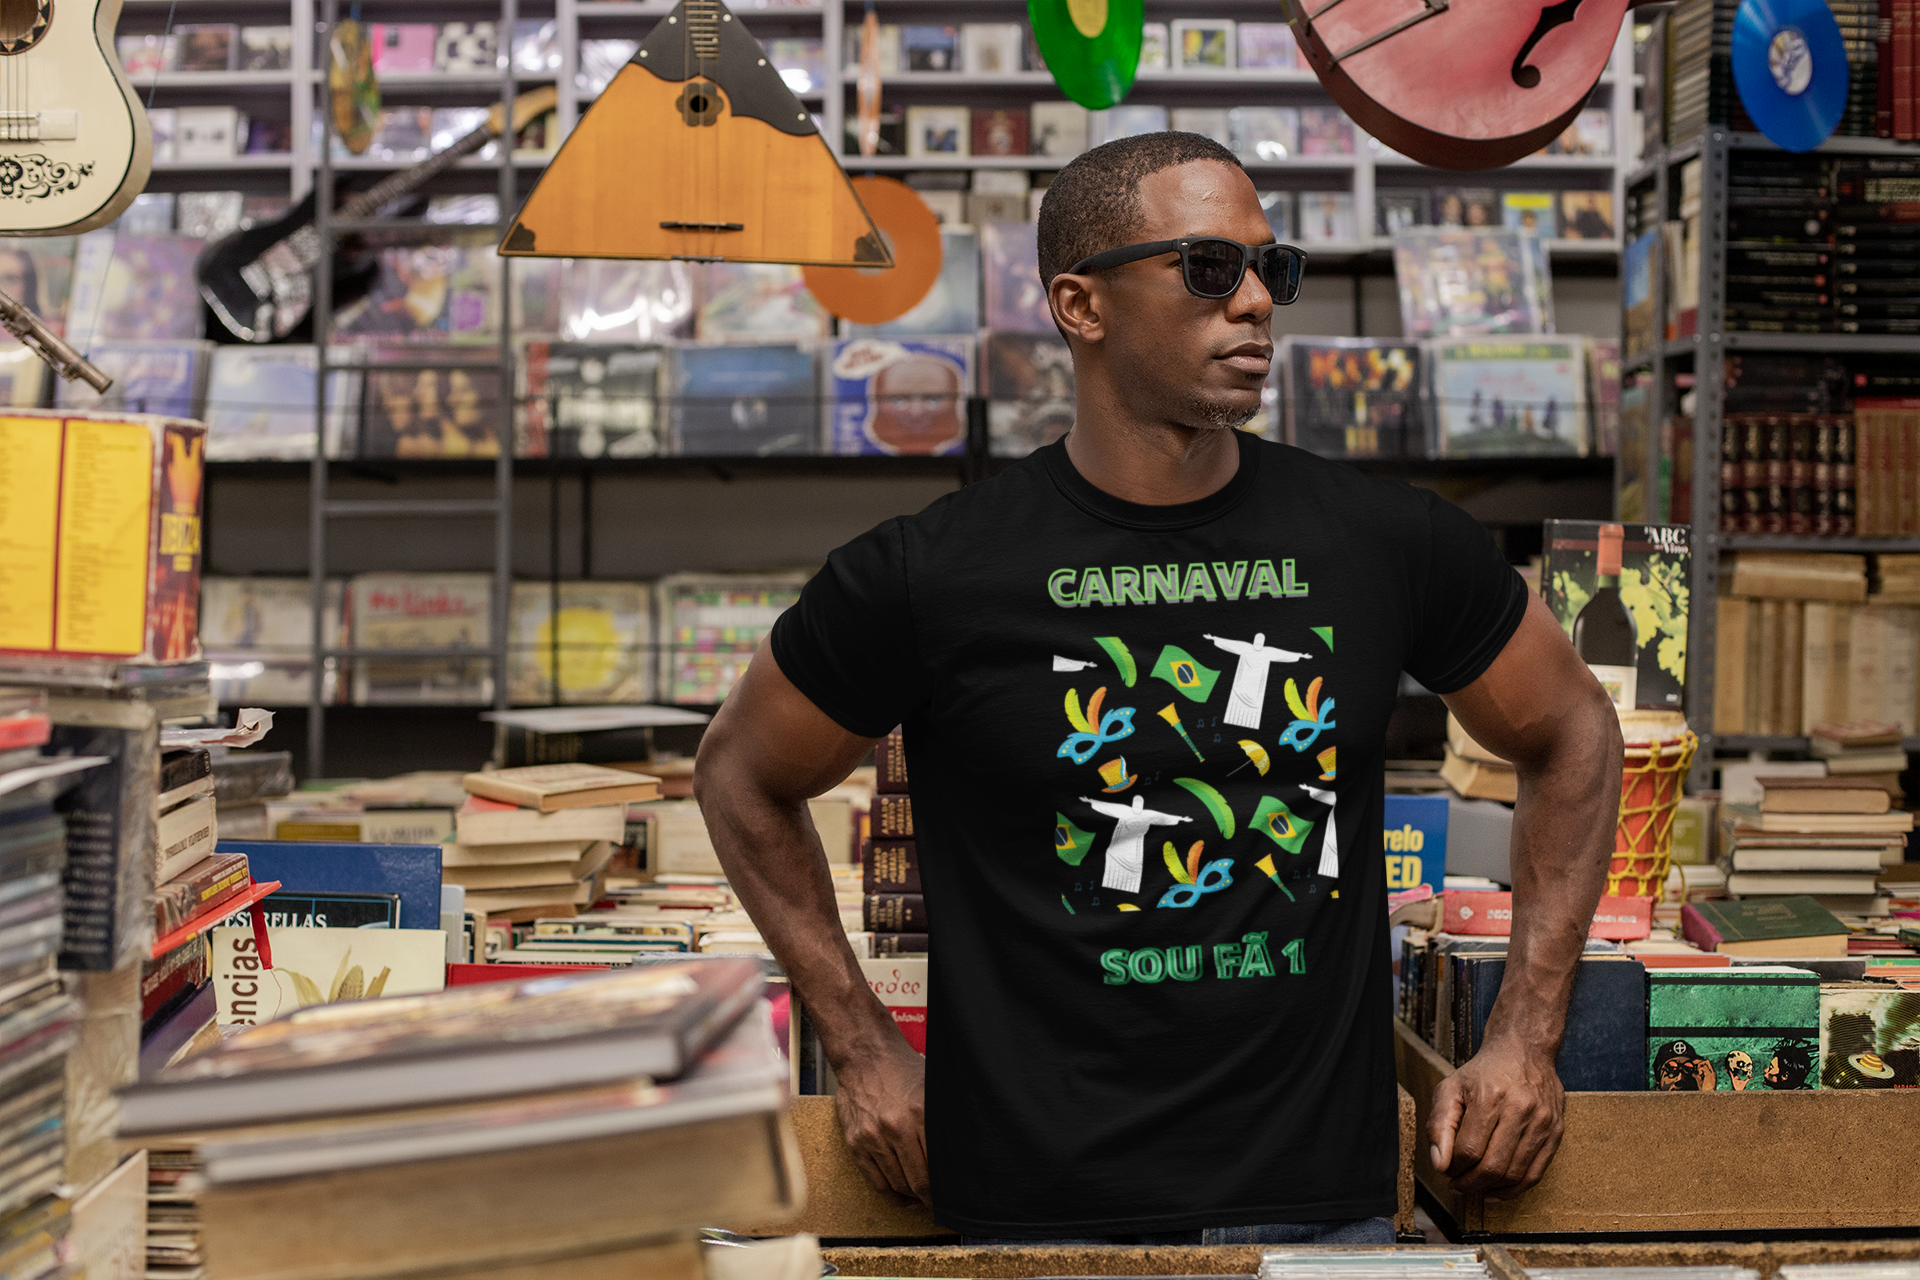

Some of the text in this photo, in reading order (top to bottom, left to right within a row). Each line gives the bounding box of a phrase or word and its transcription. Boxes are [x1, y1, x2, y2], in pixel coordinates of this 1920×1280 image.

[1648, 526, 1686, 545] ABC
[1047, 558, 1309, 607] CARNAVAL
[881, 797, 889, 835] AMADO
[874, 847, 882, 884] AMADO
[1101, 931, 1307, 985] SOU FÃ 1
